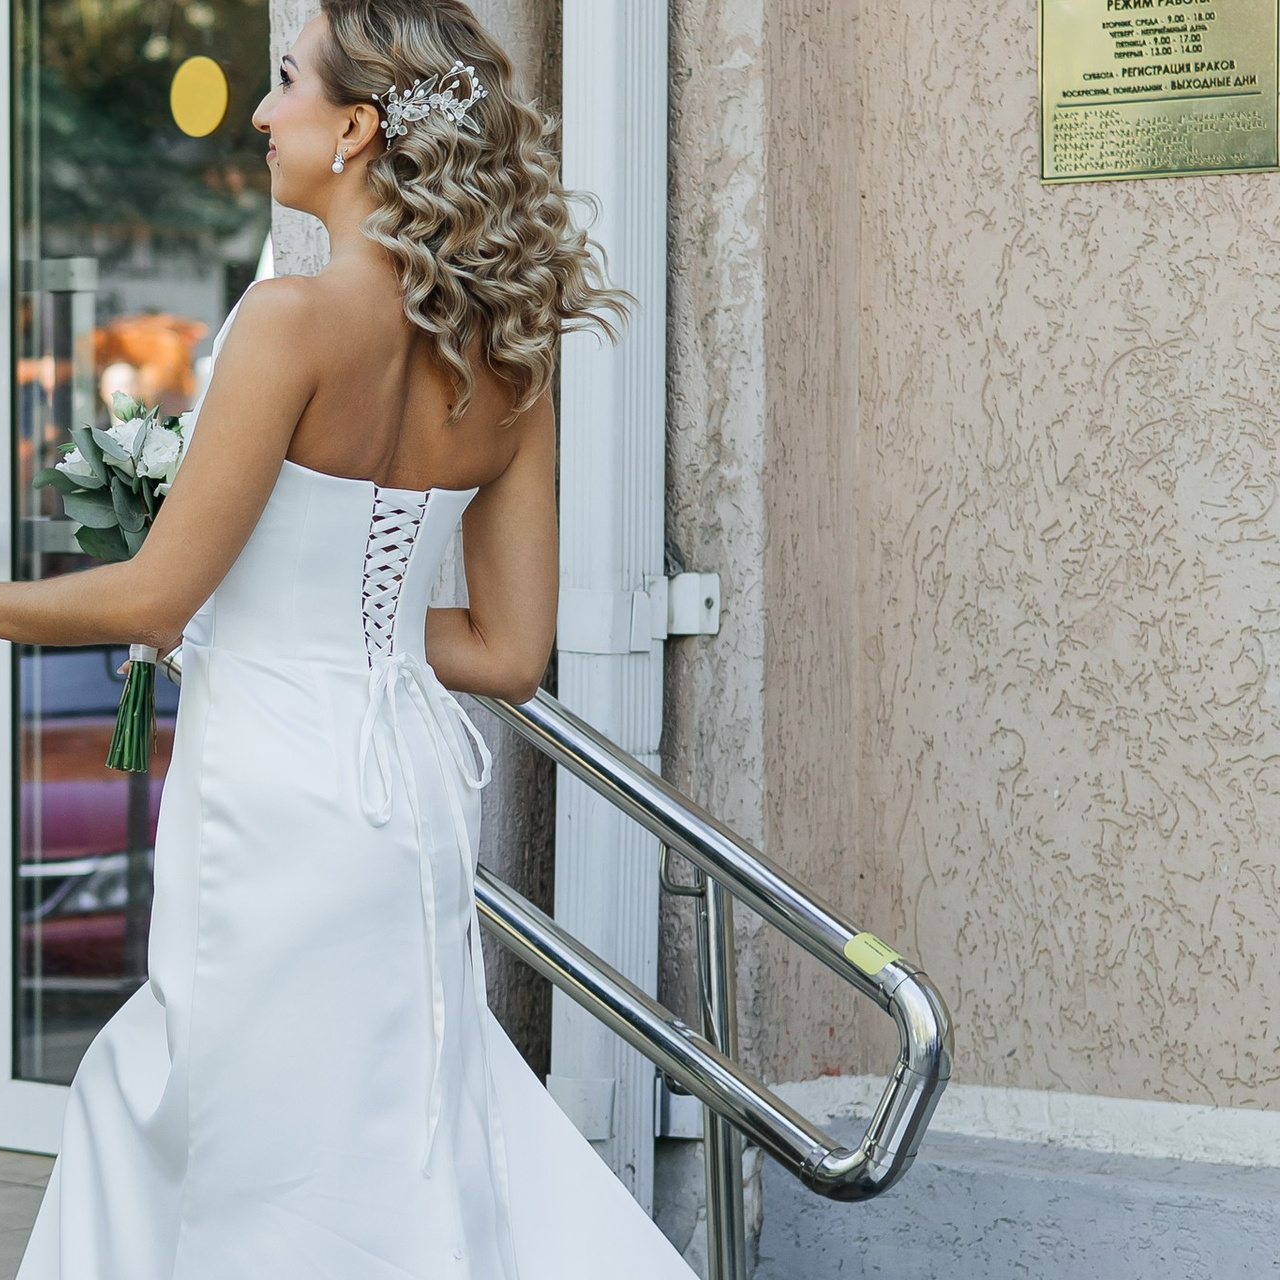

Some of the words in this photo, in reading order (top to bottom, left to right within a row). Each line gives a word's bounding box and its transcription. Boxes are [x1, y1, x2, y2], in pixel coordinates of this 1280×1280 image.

[1194, 12, 1215, 21] 18.00
[1180, 34, 1201, 43] 17.00
[1151, 47, 1172, 56] 13.00
[1181, 44, 1202, 53] 14.00
[1121, 63, 1191, 78] РЕГИСТРАЦИЯ
[1195, 59, 1235, 72] БРАКОВ
[1171, 77, 1231, 91] ВЫХОДНЫЕ
[1234, 75, 1256, 88] ДНИ
